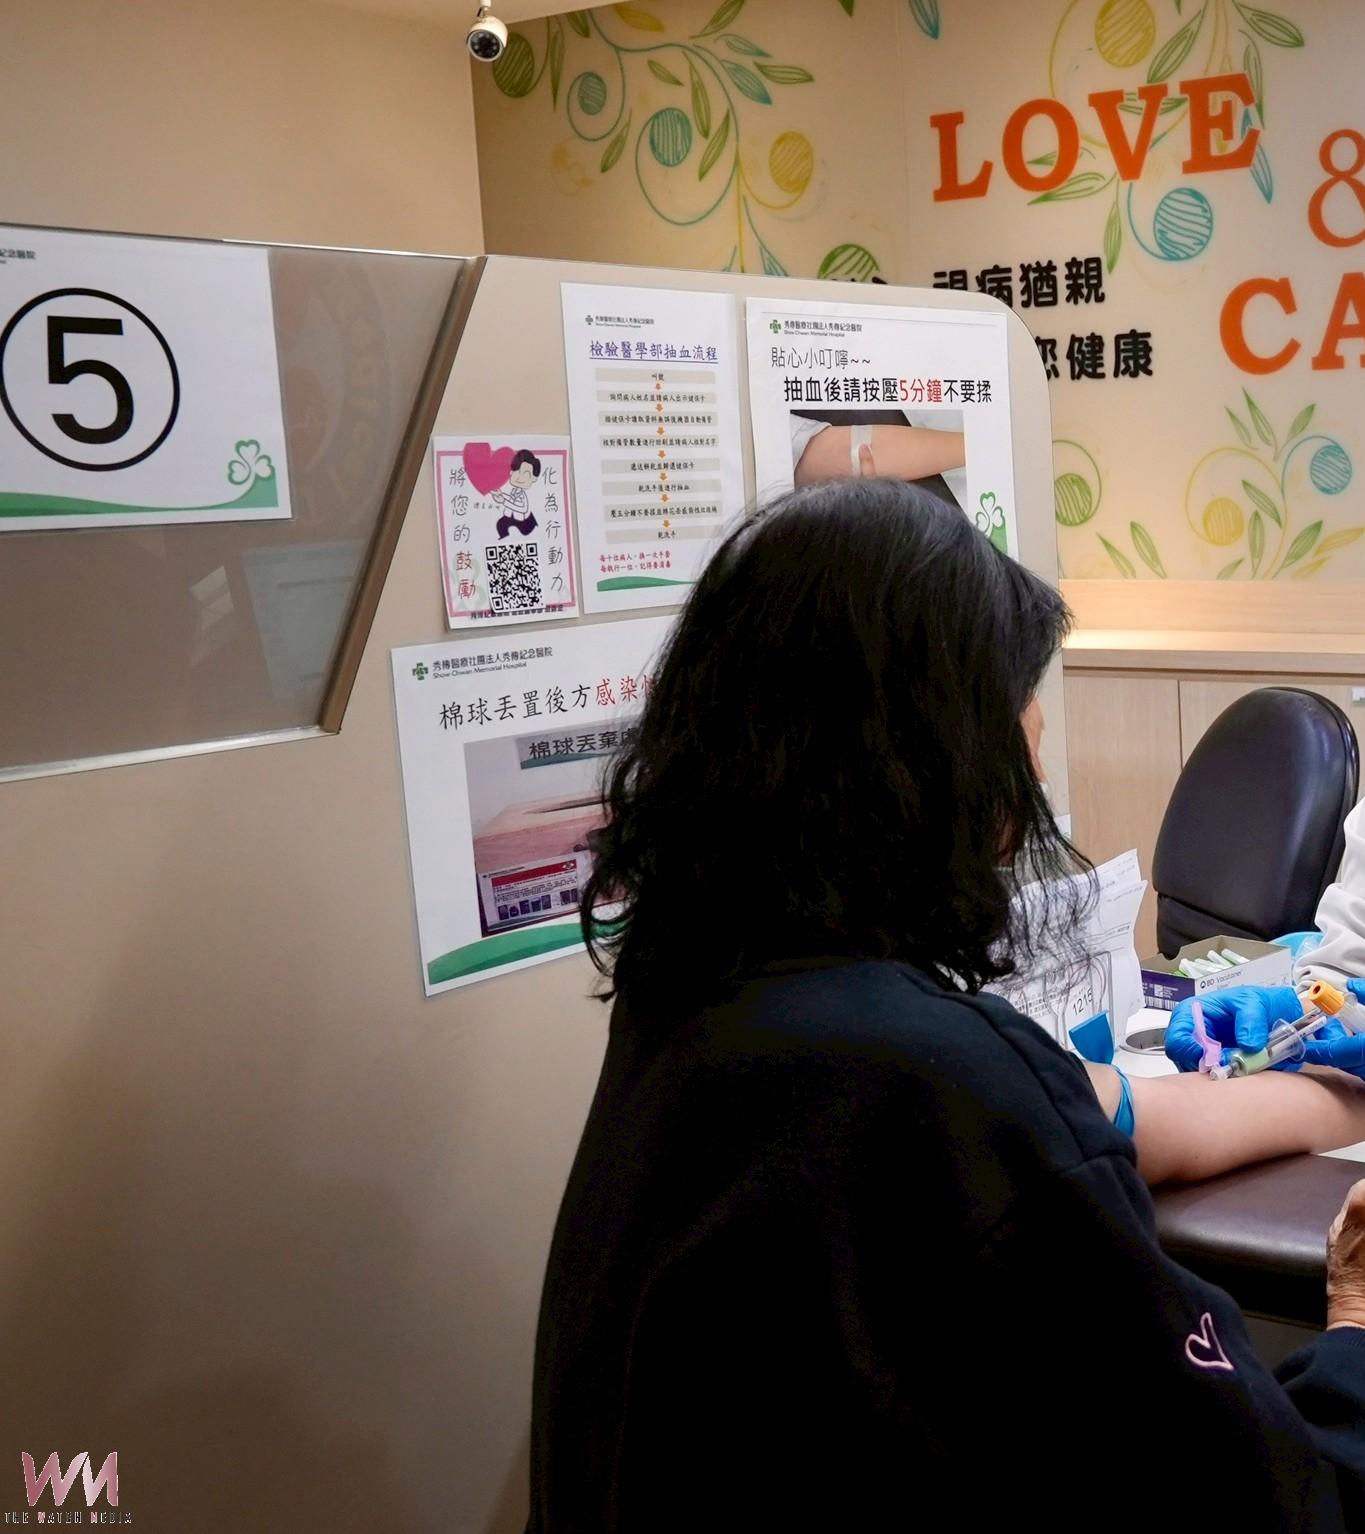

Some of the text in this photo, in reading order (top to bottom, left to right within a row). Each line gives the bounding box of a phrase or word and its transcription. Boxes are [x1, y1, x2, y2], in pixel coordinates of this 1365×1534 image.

[931, 73, 1260, 202] LOVE
[46, 316, 134, 444] 5
[589, 340, 718, 360] 檢驗醫學部抽血流程
[784, 376, 992, 404] 抽血後請按壓5分鐘不要揉
[449, 468, 476, 600] 將您的鼓勵
[542, 466, 564, 593] 化為行動力
